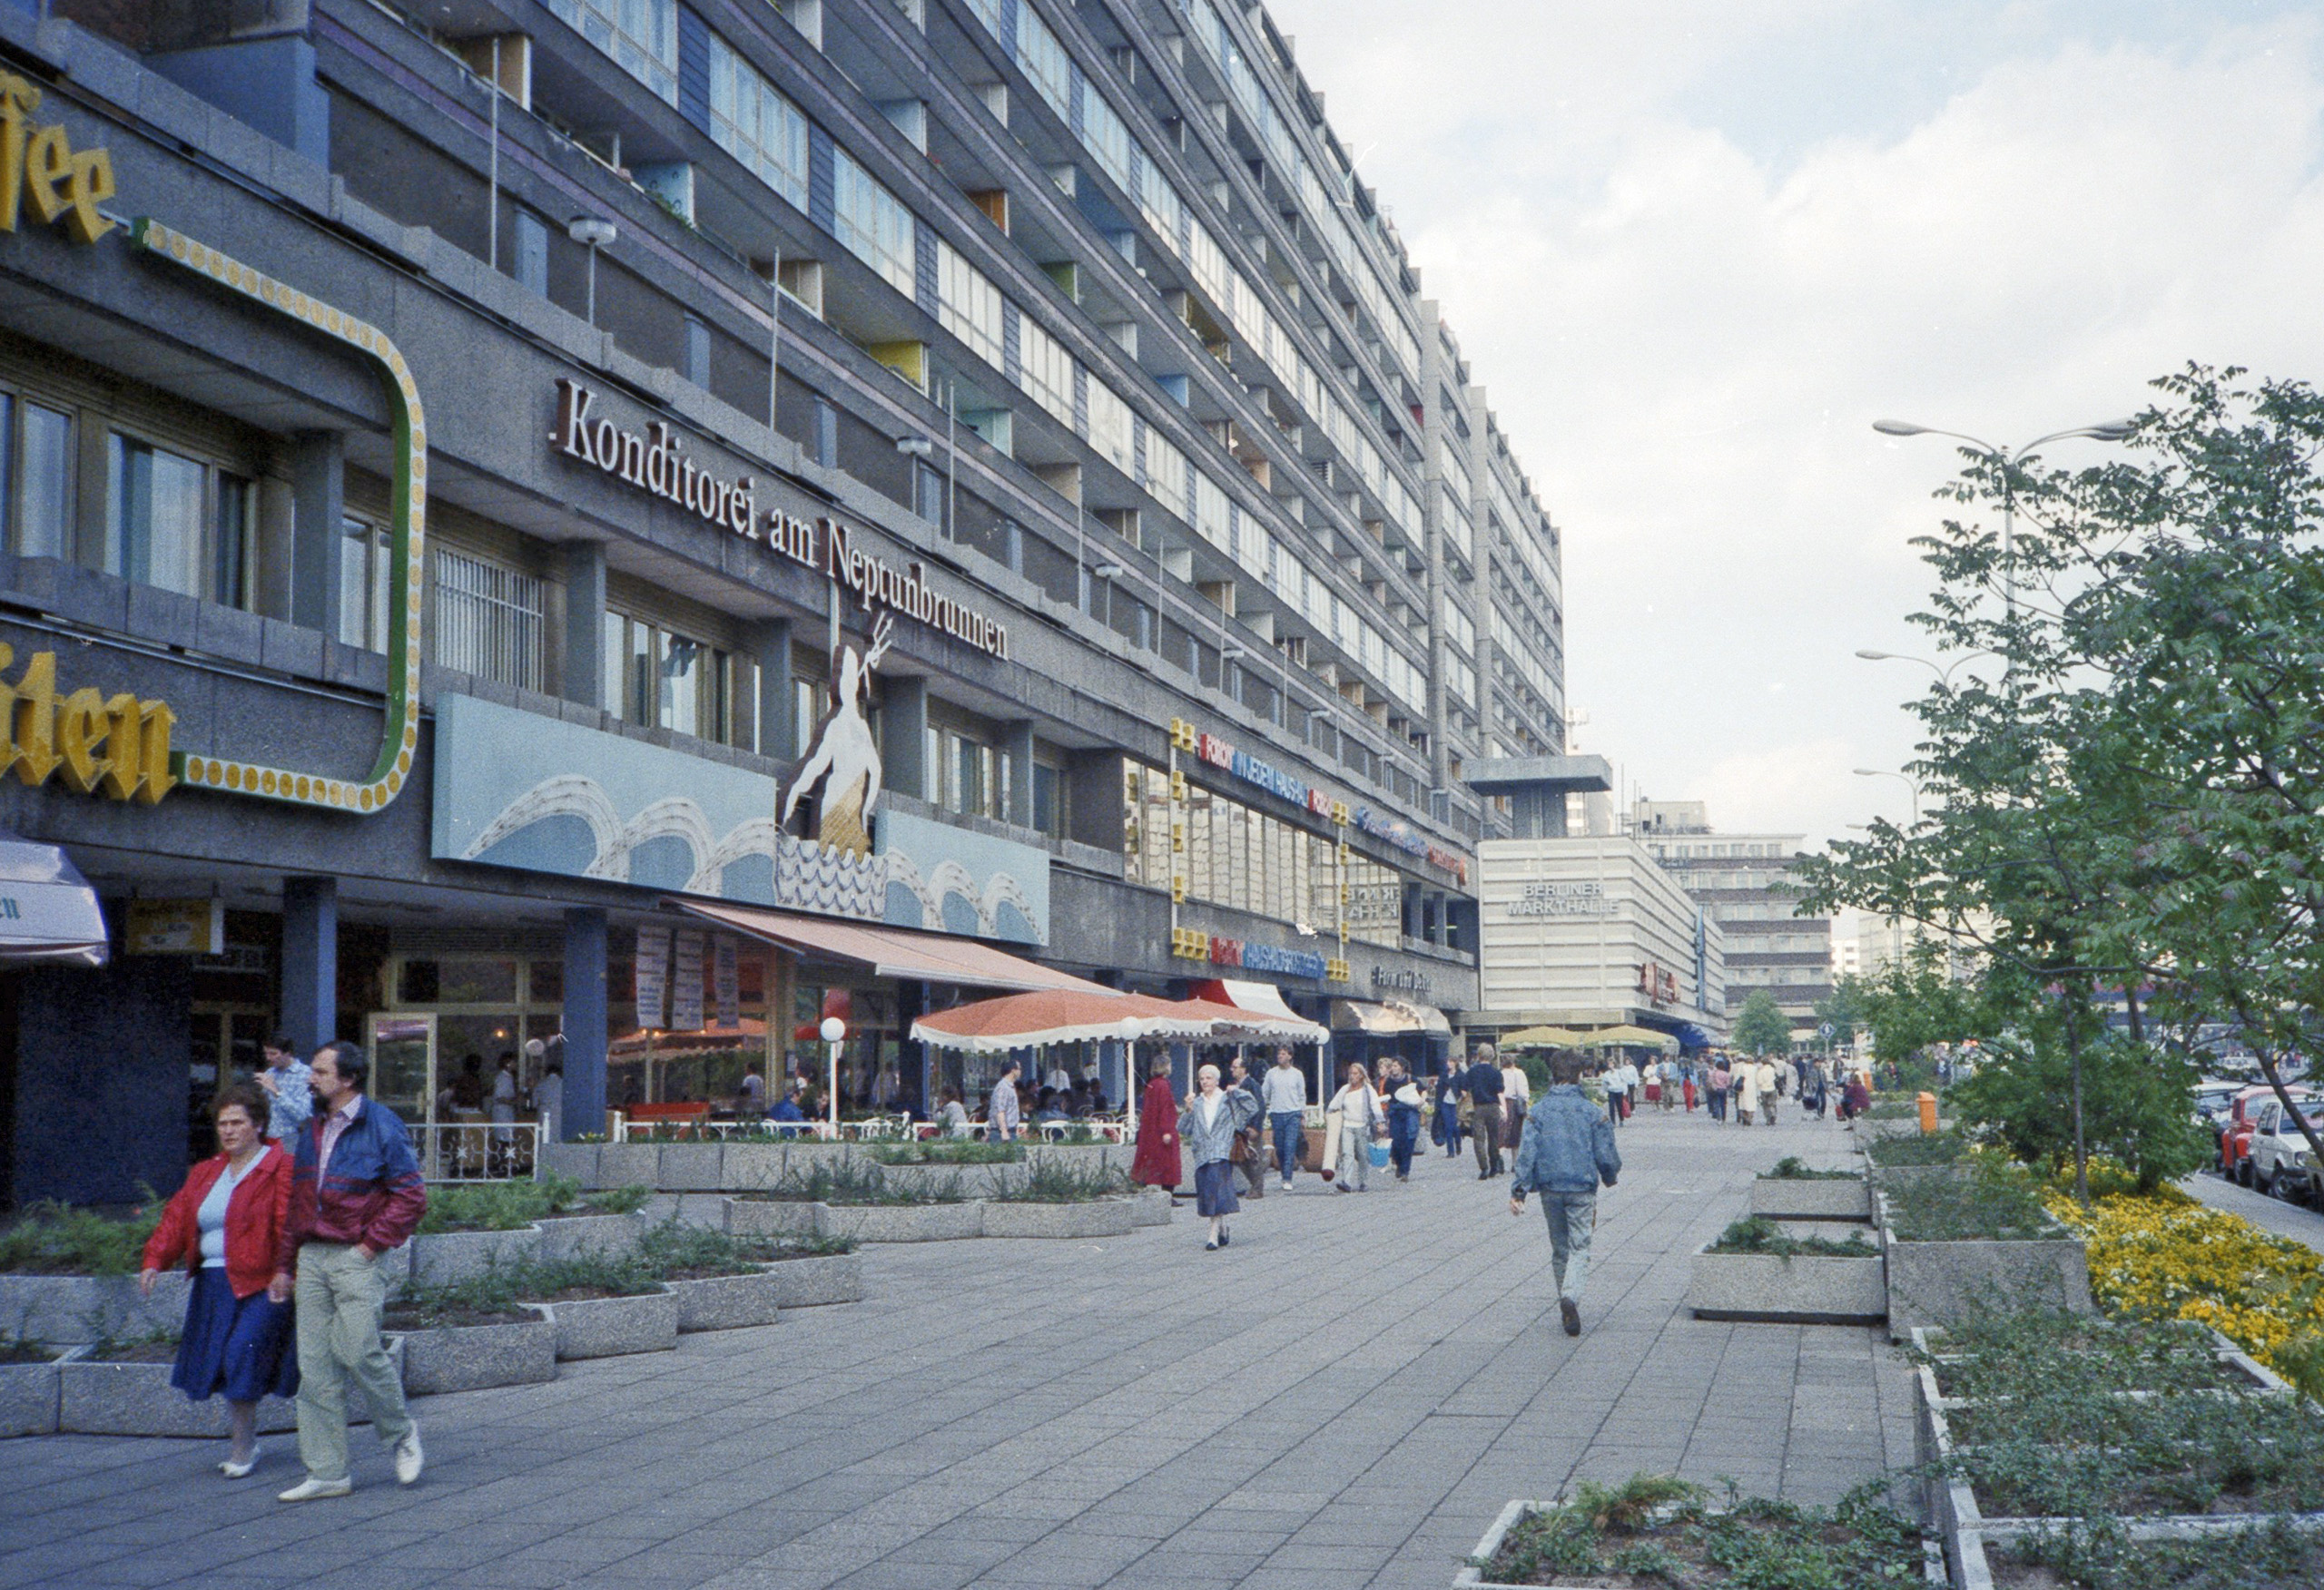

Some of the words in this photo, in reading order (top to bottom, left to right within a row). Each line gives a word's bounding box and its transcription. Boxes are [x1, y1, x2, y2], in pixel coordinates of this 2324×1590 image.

[561, 378, 760, 541] Konditorei
[770, 507, 820, 568] am
[827, 517, 1009, 662] Neptunbrunnen
[1524, 883, 1604, 898] BERLINER
[1507, 899, 1620, 916] MARKTHALLE
